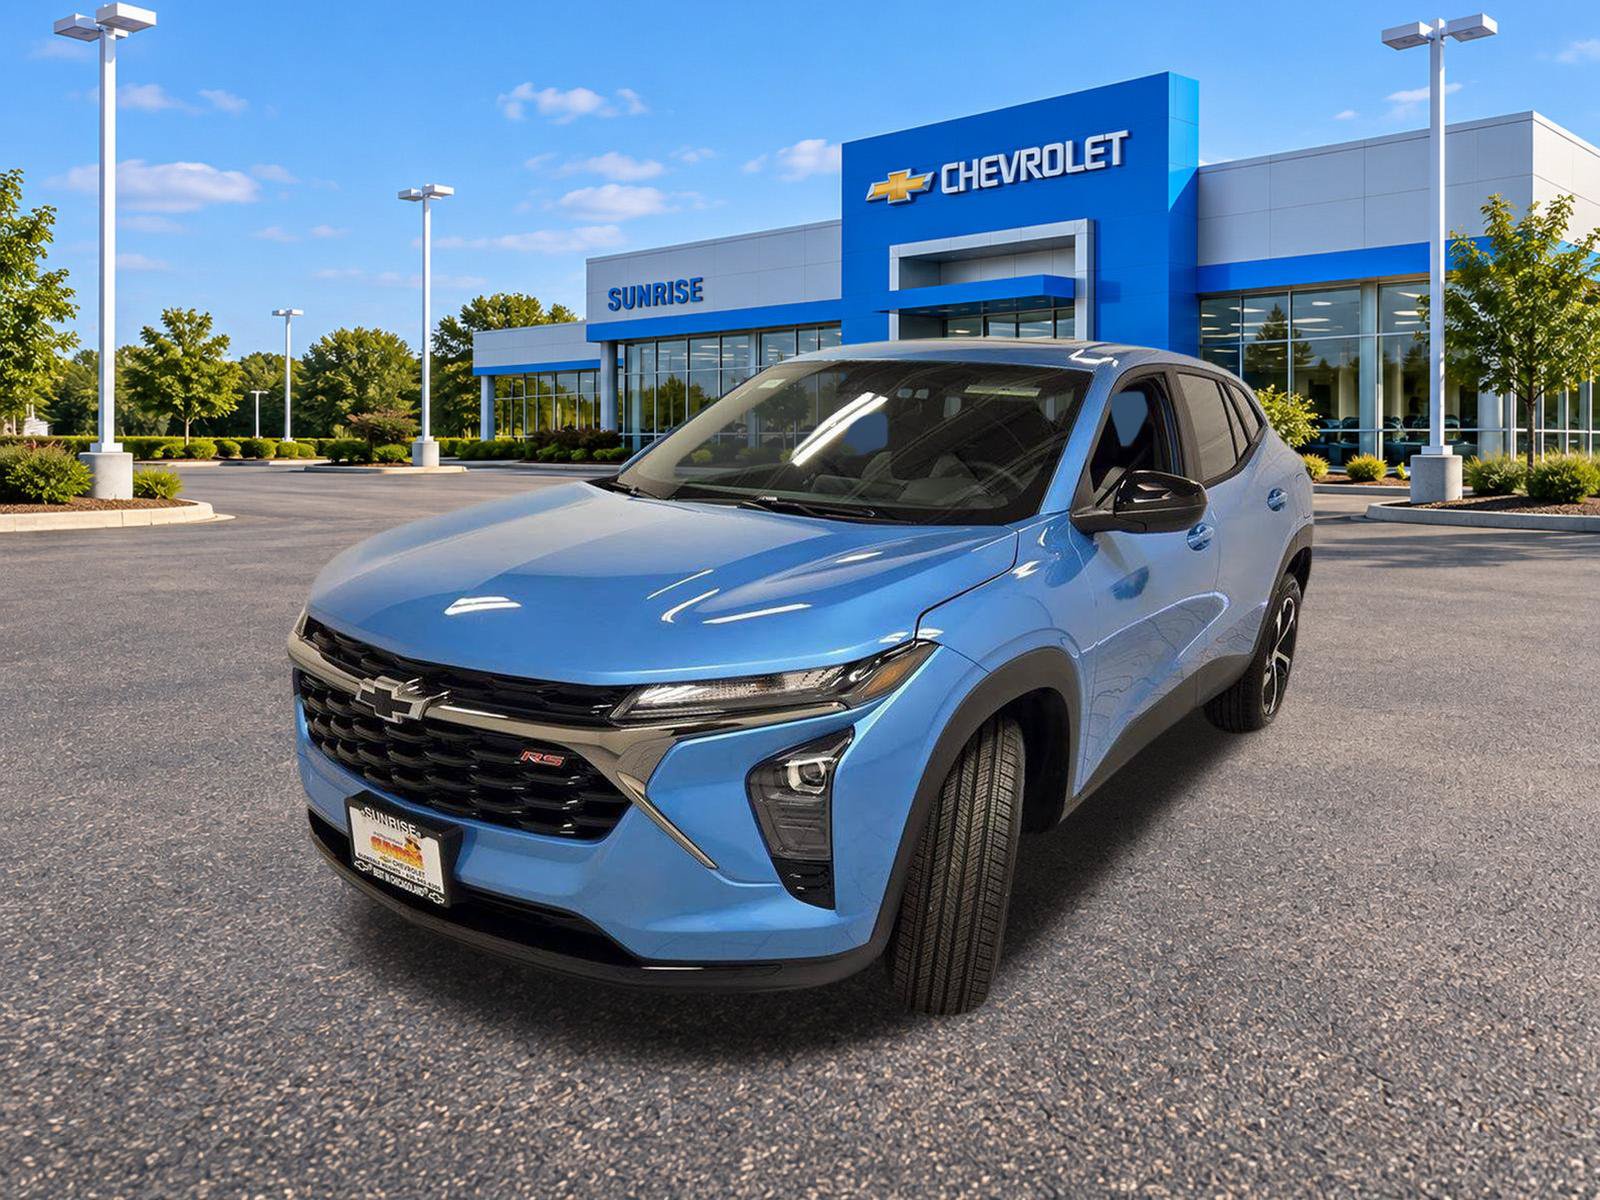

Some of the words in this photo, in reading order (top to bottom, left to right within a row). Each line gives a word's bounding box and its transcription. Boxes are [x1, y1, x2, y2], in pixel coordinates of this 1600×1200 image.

[941, 129, 1129, 195] CHEVROLET
[608, 277, 704, 312] SUNRISE
[520, 751, 565, 767] RS
[364, 807, 417, 836] SUNRISE
